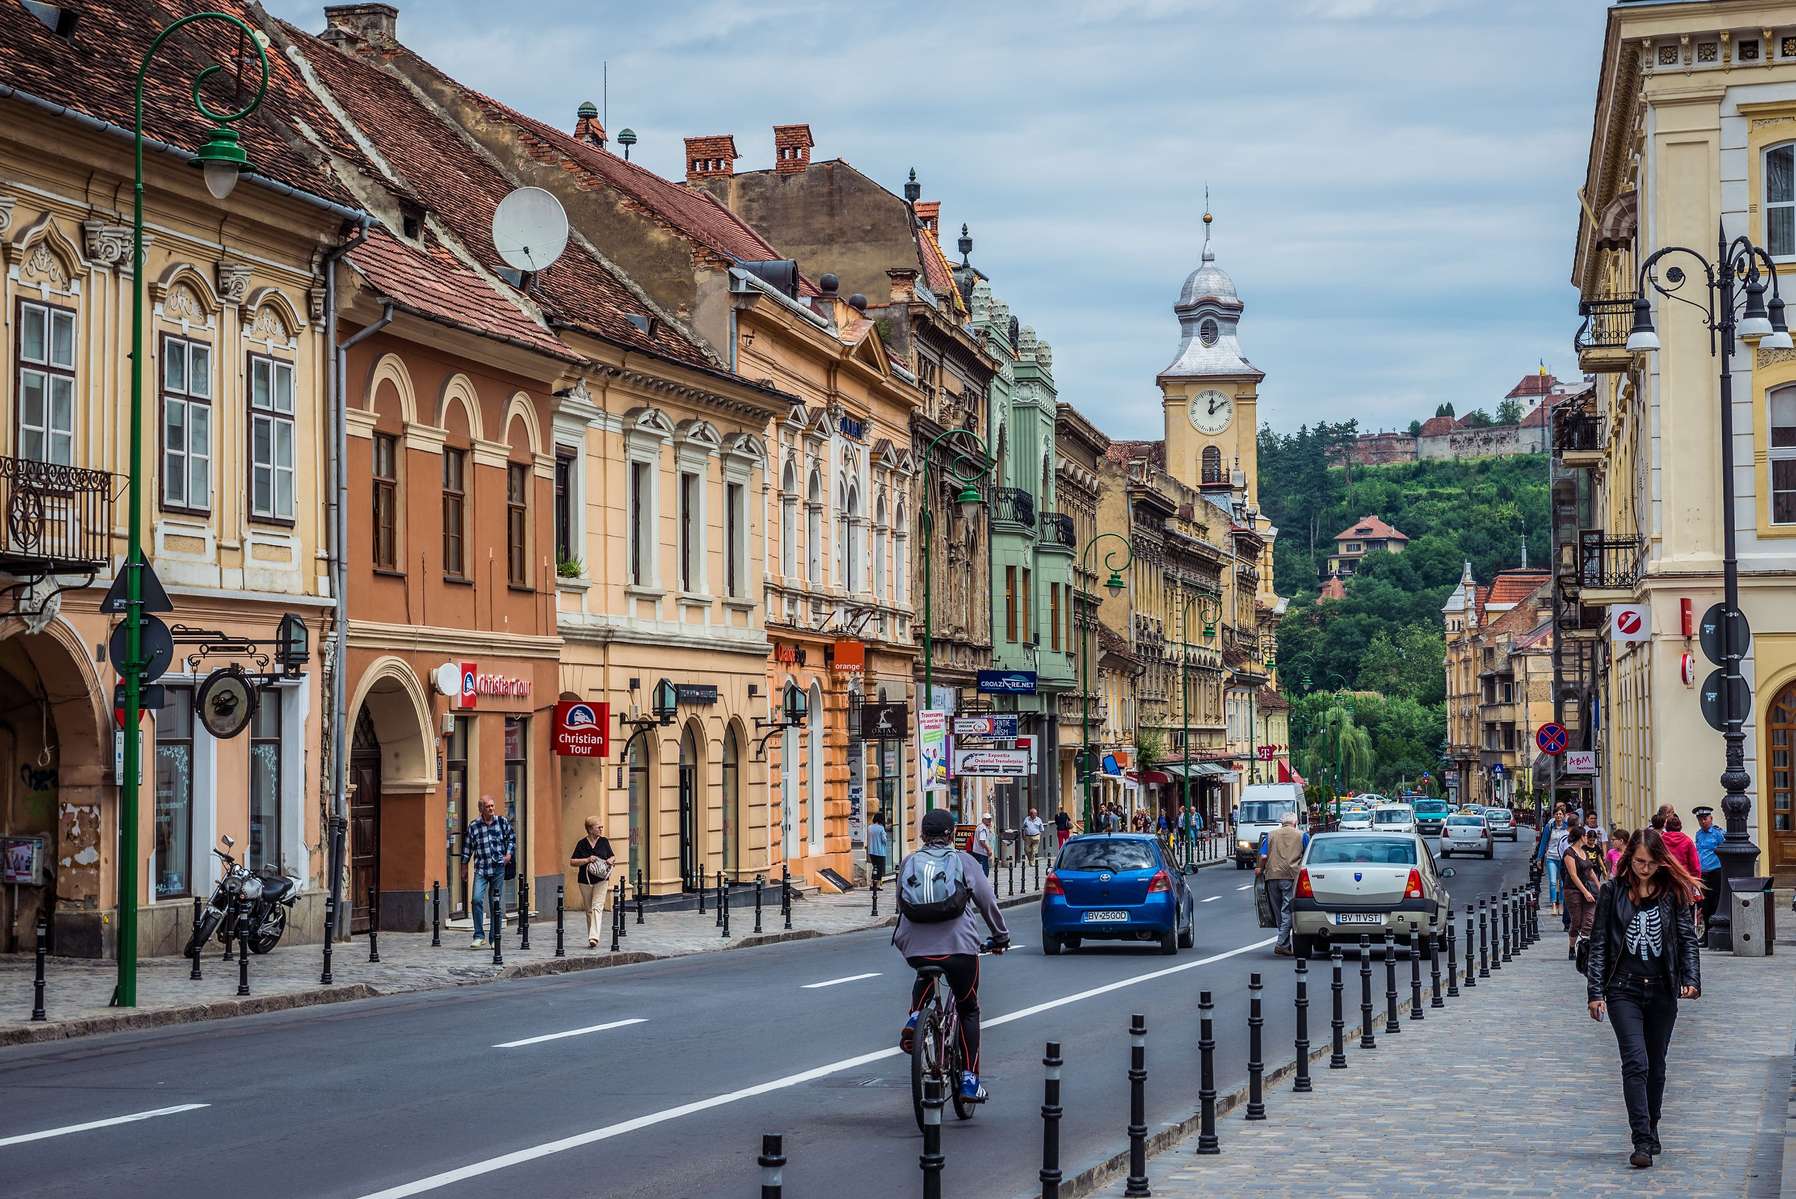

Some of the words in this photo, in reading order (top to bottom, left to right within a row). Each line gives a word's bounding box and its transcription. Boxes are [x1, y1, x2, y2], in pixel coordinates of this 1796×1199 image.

[835, 663, 861, 671] orange
[559, 733, 603, 744] Christian
[570, 745, 592, 754] Tour
[1341, 914, 1352, 922] BV
[1362, 914, 1378, 922] VST
